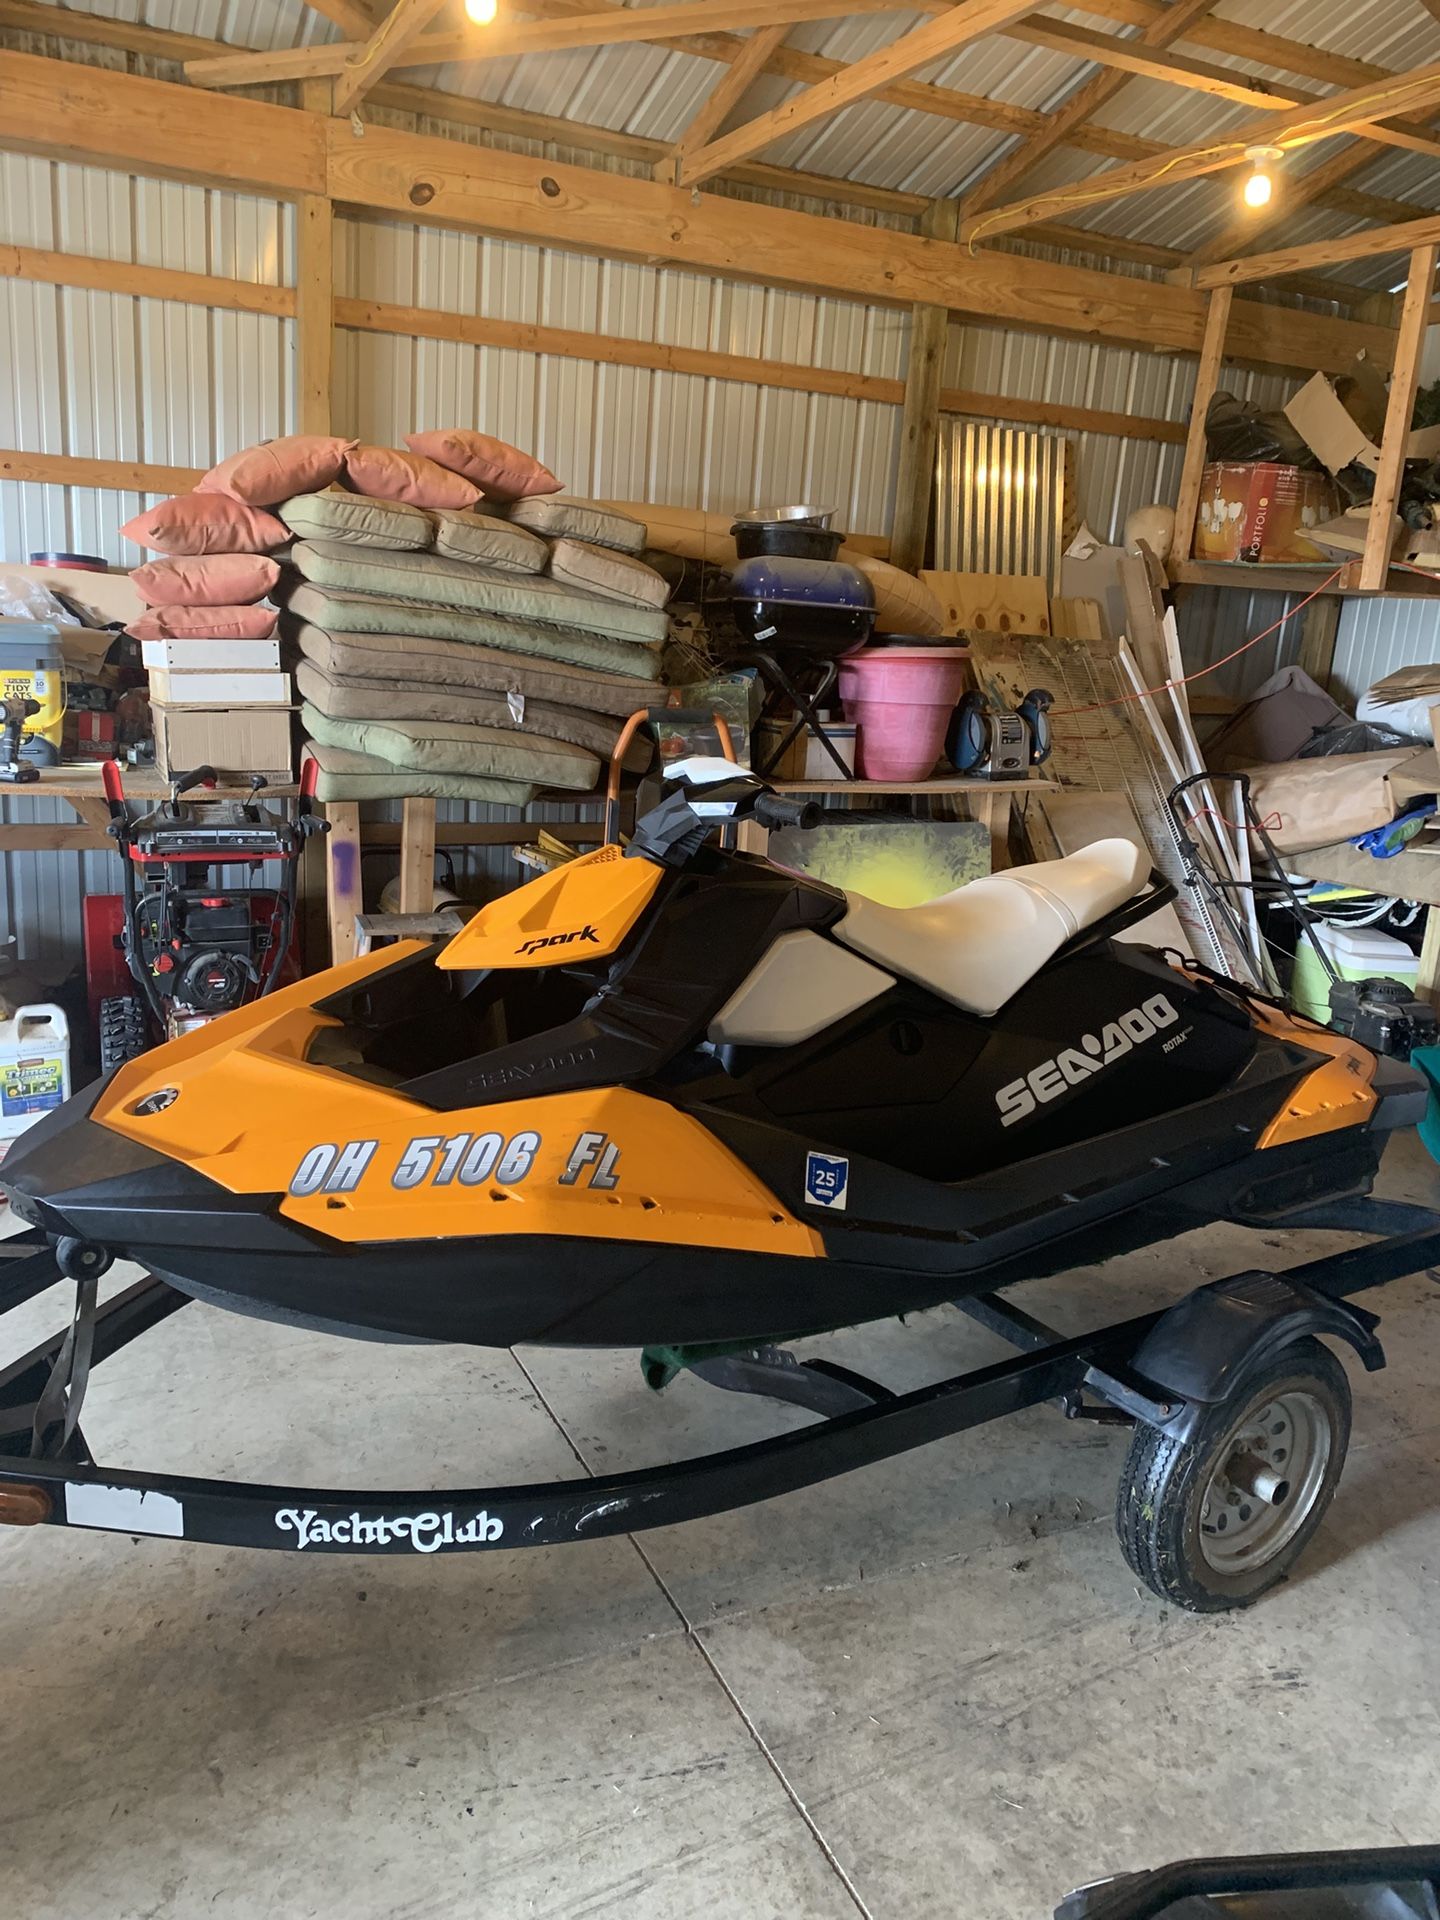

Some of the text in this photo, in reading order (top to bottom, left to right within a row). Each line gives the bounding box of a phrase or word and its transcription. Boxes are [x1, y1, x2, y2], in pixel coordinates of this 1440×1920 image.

[1249, 497, 1269, 556] PORTFOLIO
[4, 692, 32, 700] CATS
[514, 925, 600, 955] spark
[1161, 1031, 1188, 1054] ROTAX
[6, 1066, 57, 1079] Trimec
[288, 1130, 623, 1197] OH 5106 FL
[815, 1170, 836, 1187] 25
